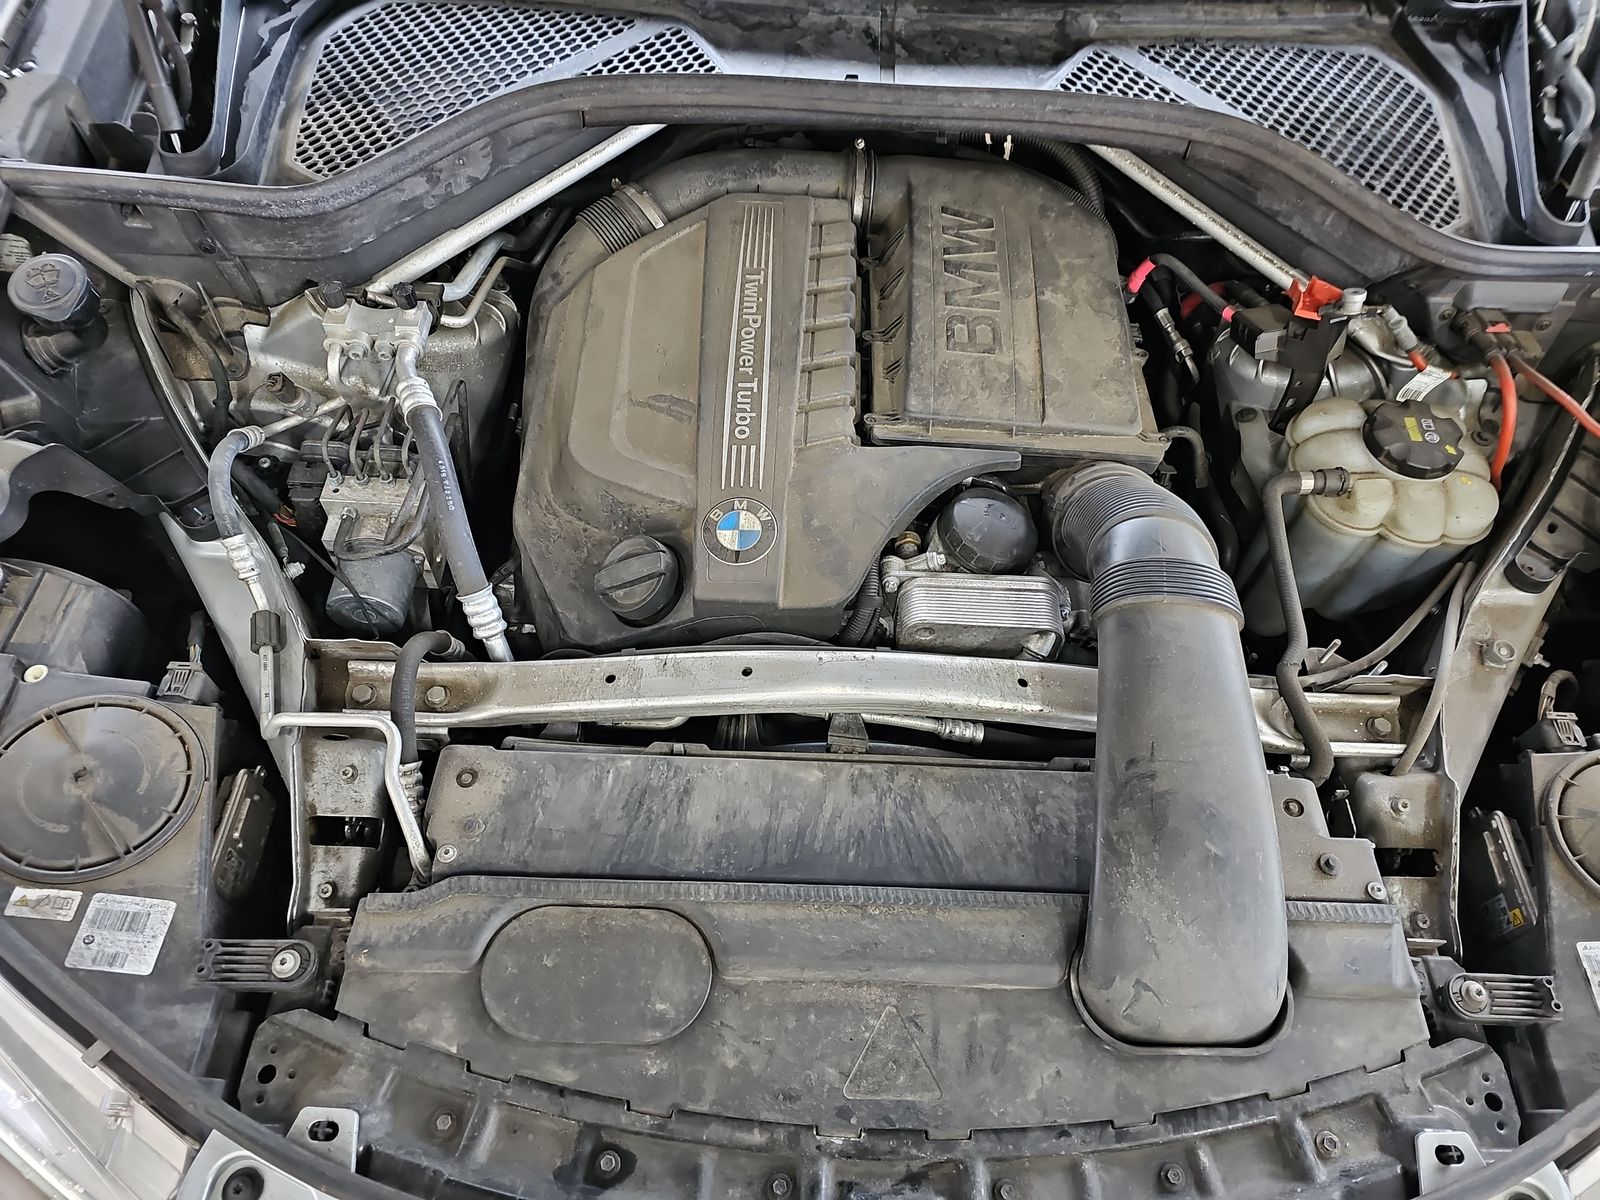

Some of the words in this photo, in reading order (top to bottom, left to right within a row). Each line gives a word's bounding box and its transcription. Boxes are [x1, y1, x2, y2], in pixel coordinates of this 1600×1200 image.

[941, 206, 1001, 354] BMW
[738, 270, 764, 376] TwinPower
[734, 377, 758, 439] Turbo
[709, 500, 772, 521] BMW
